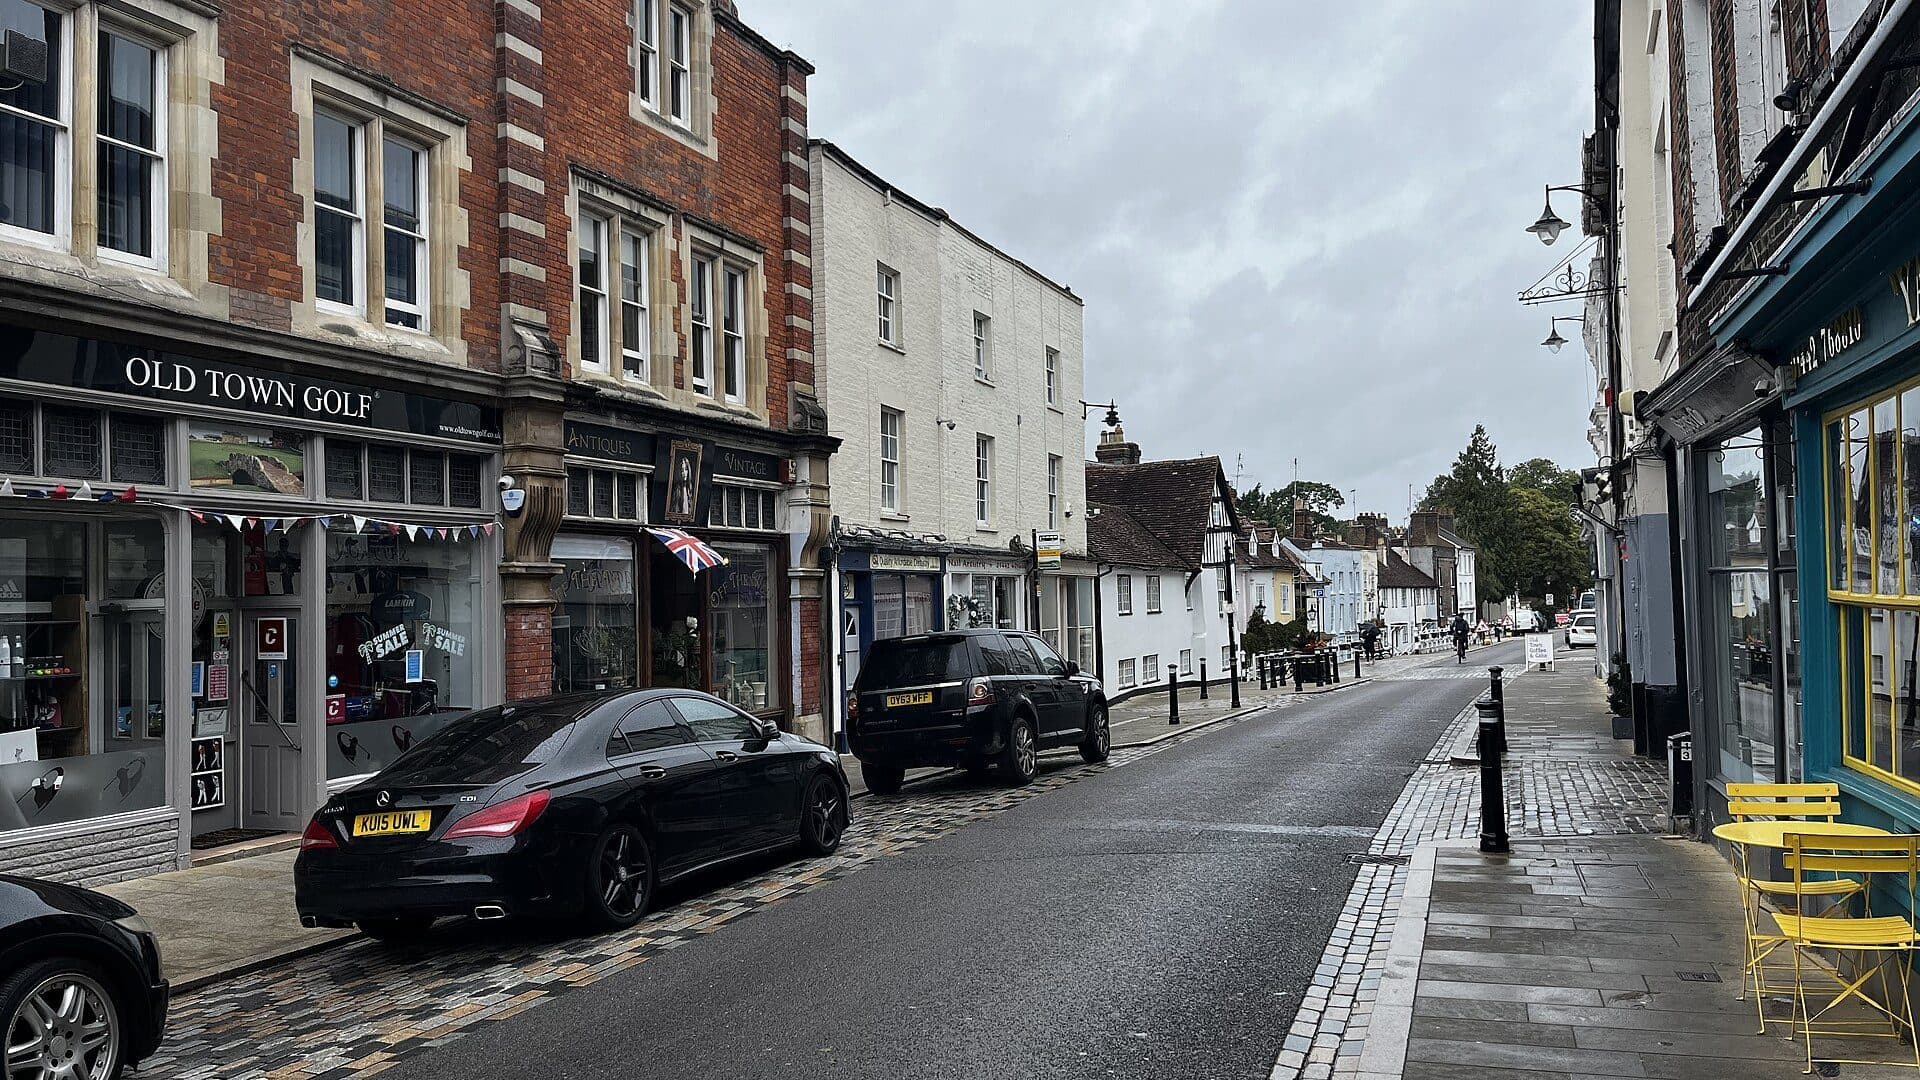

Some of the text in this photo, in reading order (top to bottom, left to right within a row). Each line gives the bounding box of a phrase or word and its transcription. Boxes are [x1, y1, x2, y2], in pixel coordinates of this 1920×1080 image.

[125, 357, 373, 418] OLD TOWN GOLF
[438, 424, 502, 440] www.oldtowngolf.co.uk
[373, 623, 406, 646] SUMMER
[376, 630, 409, 659] SALE
[436, 627, 466, 643] SUMMER
[434, 635, 465, 656] SALE
[361, 812, 420, 832] KU15 UWL
